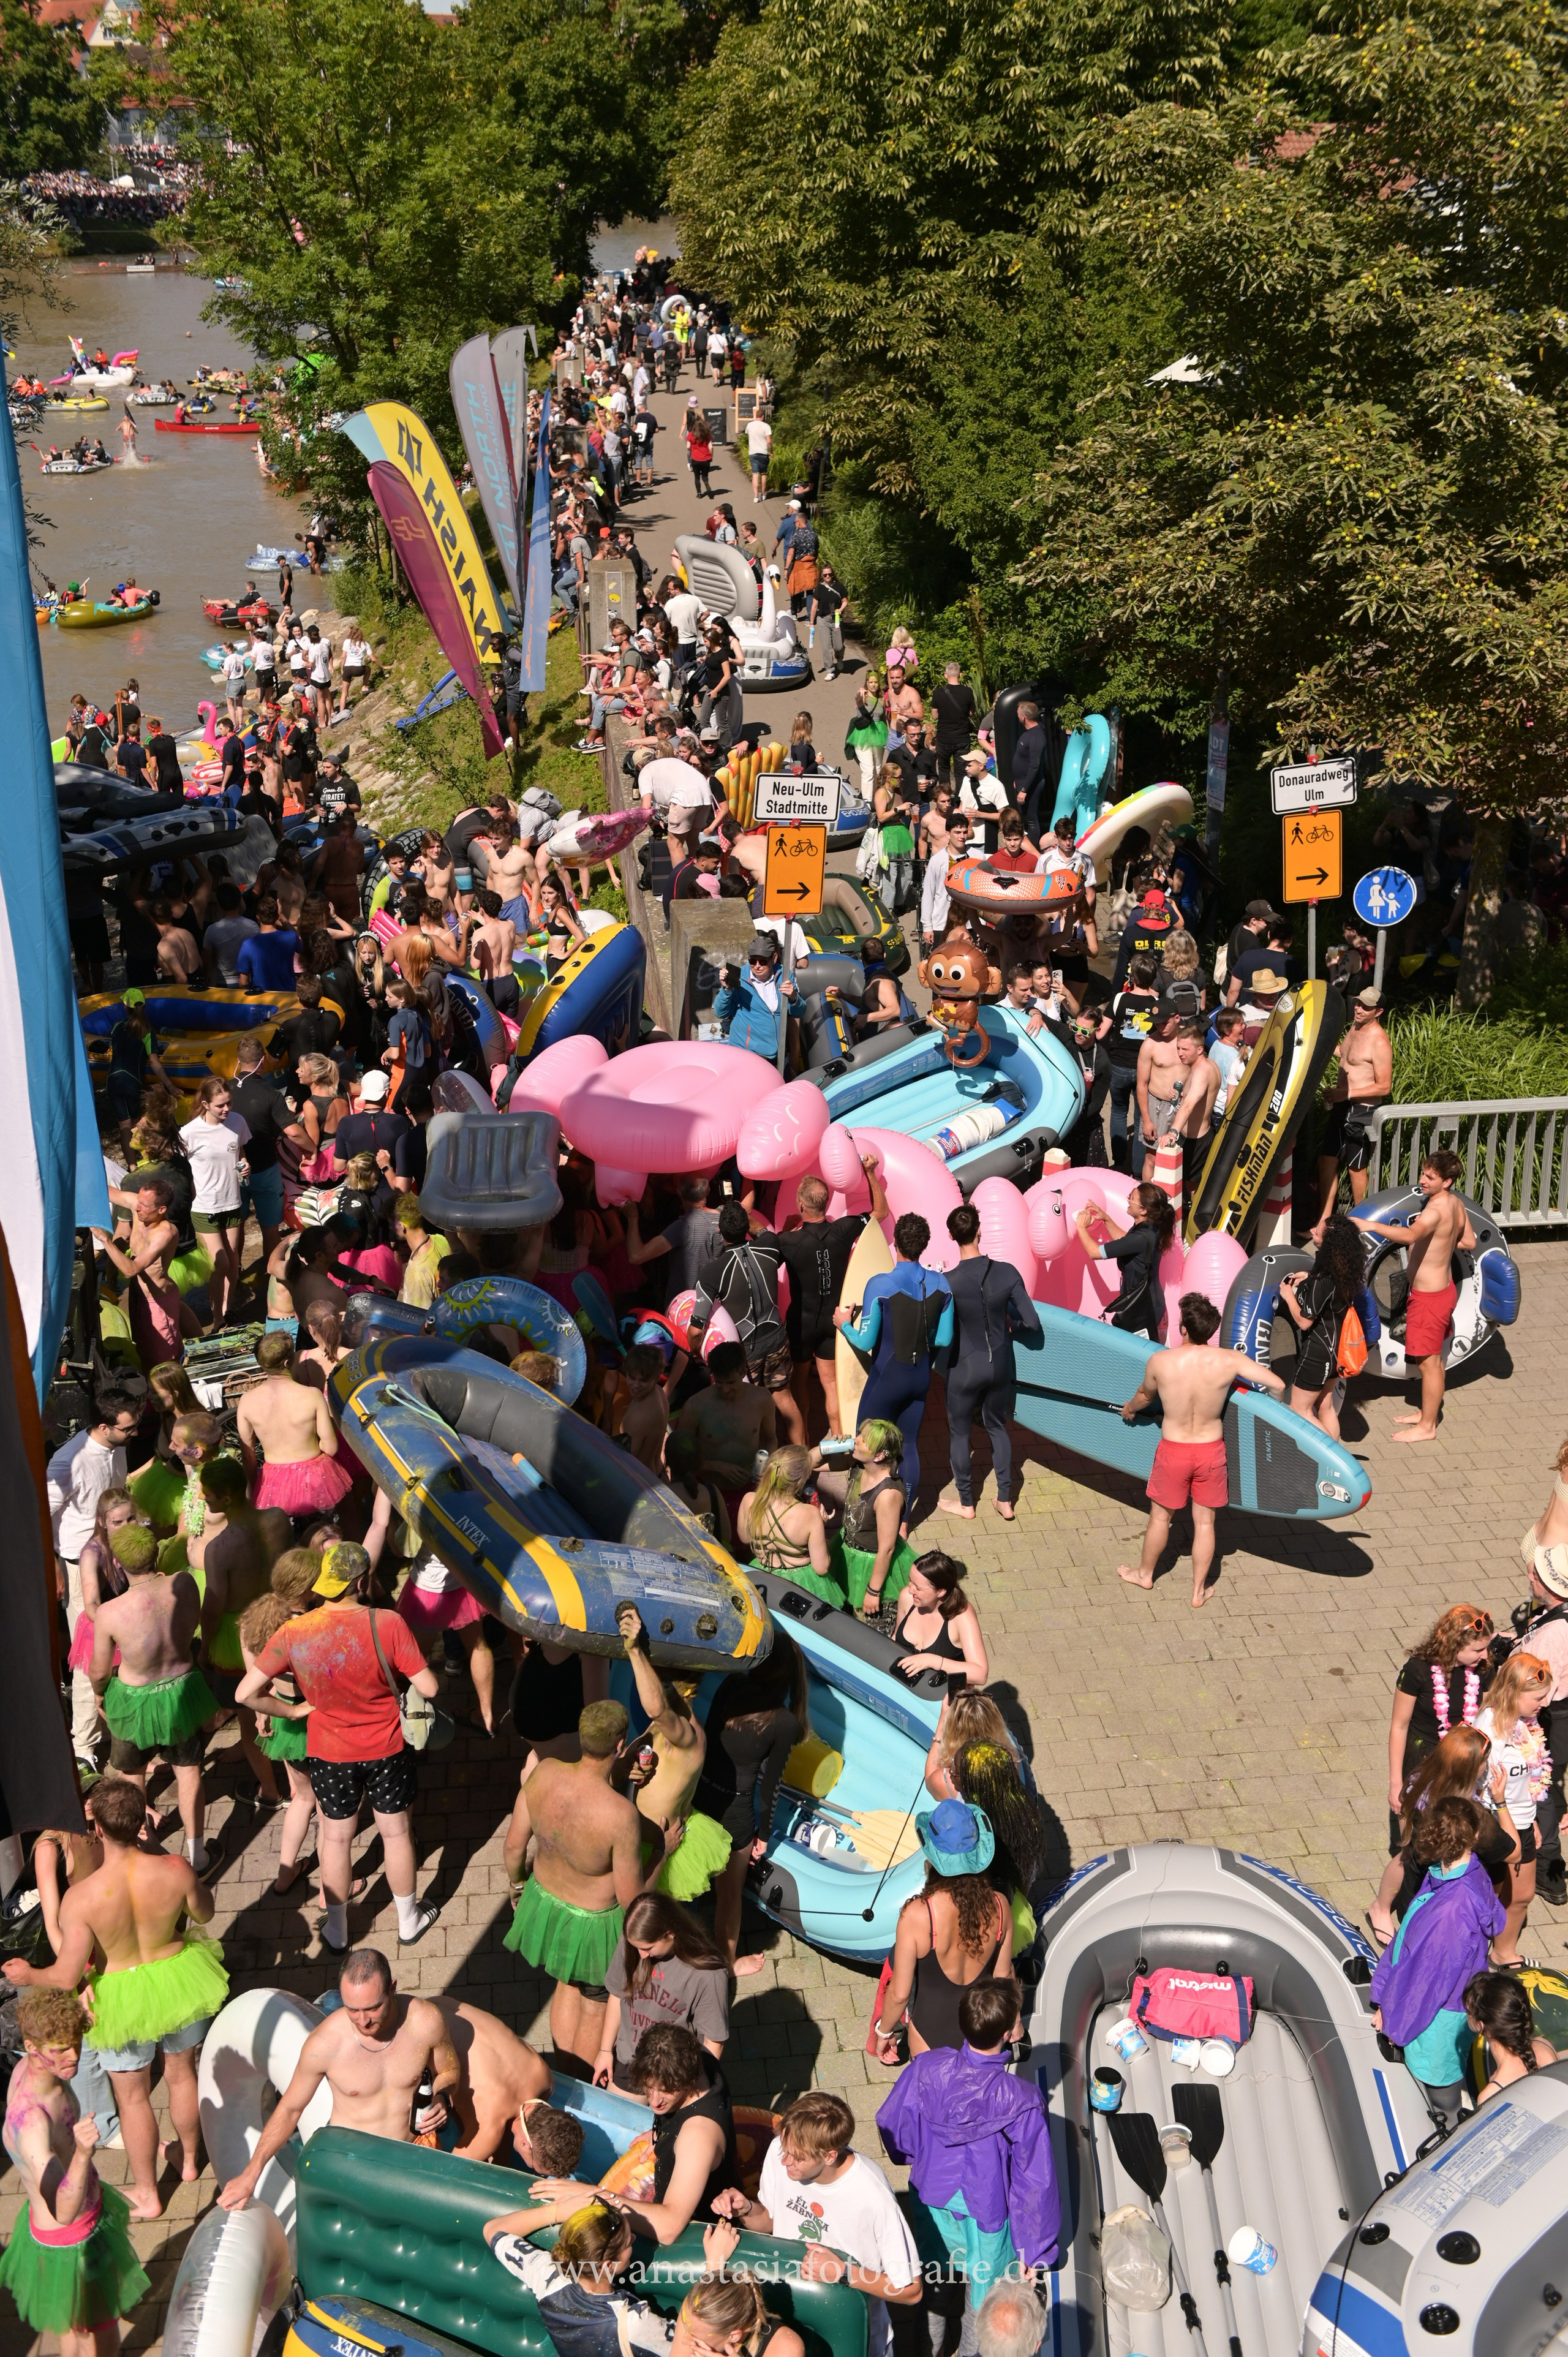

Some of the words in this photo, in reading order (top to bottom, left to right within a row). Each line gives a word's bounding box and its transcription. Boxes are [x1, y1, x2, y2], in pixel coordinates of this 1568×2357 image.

[464, 381, 507, 509] NORTH
[1279, 769, 1348, 788] Donauradweg
[772, 782, 824, 796] Neu-Ulm
[1305, 789, 1324, 801] Ulm
[766, 799, 828, 815] Stadtmitte
[1269, 1089, 1284, 1115] 200
[1237, 1133, 1272, 1204] FISHMAN
[455, 1515, 489, 1548] INTEX
[1169, 1978, 1232, 1991] mistral
[796, 2196, 808, 2209] ÉL
